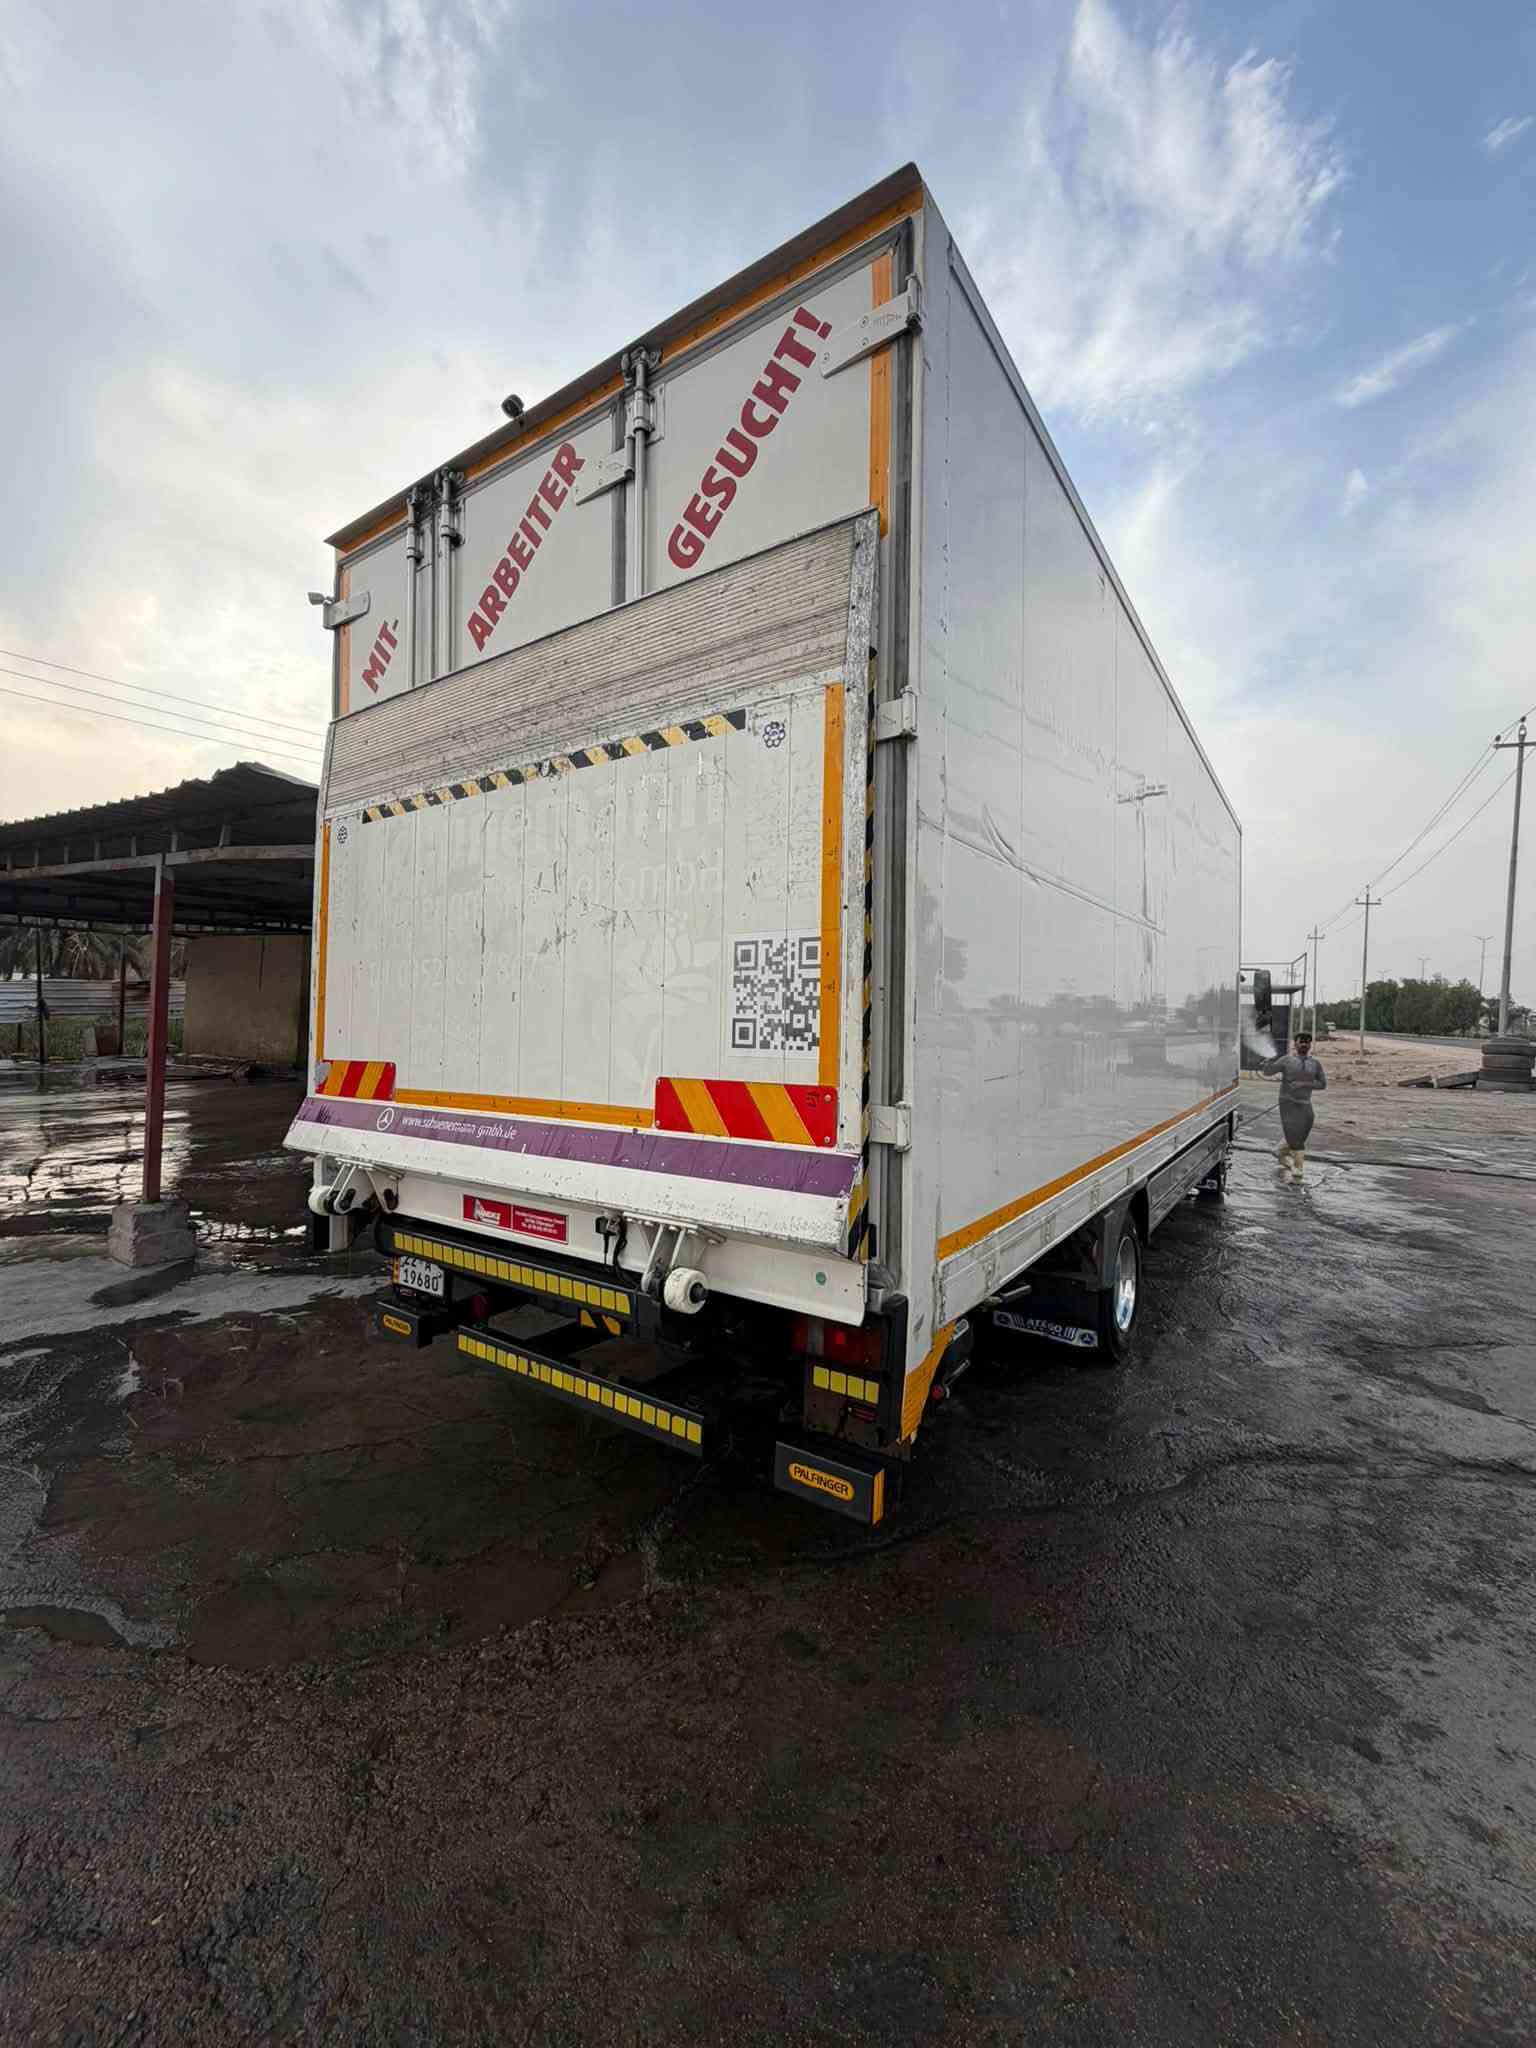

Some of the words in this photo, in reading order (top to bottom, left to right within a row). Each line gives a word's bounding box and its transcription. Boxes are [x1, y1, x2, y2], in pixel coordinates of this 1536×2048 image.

[361, 619, 399, 694] MIT-
[466, 441, 586, 652] ARBEITER
[667, 306, 832, 570] GESUCHT!
[403, 1267, 439, 1292] 19680
[793, 1465, 849, 1497] PALFINGER
